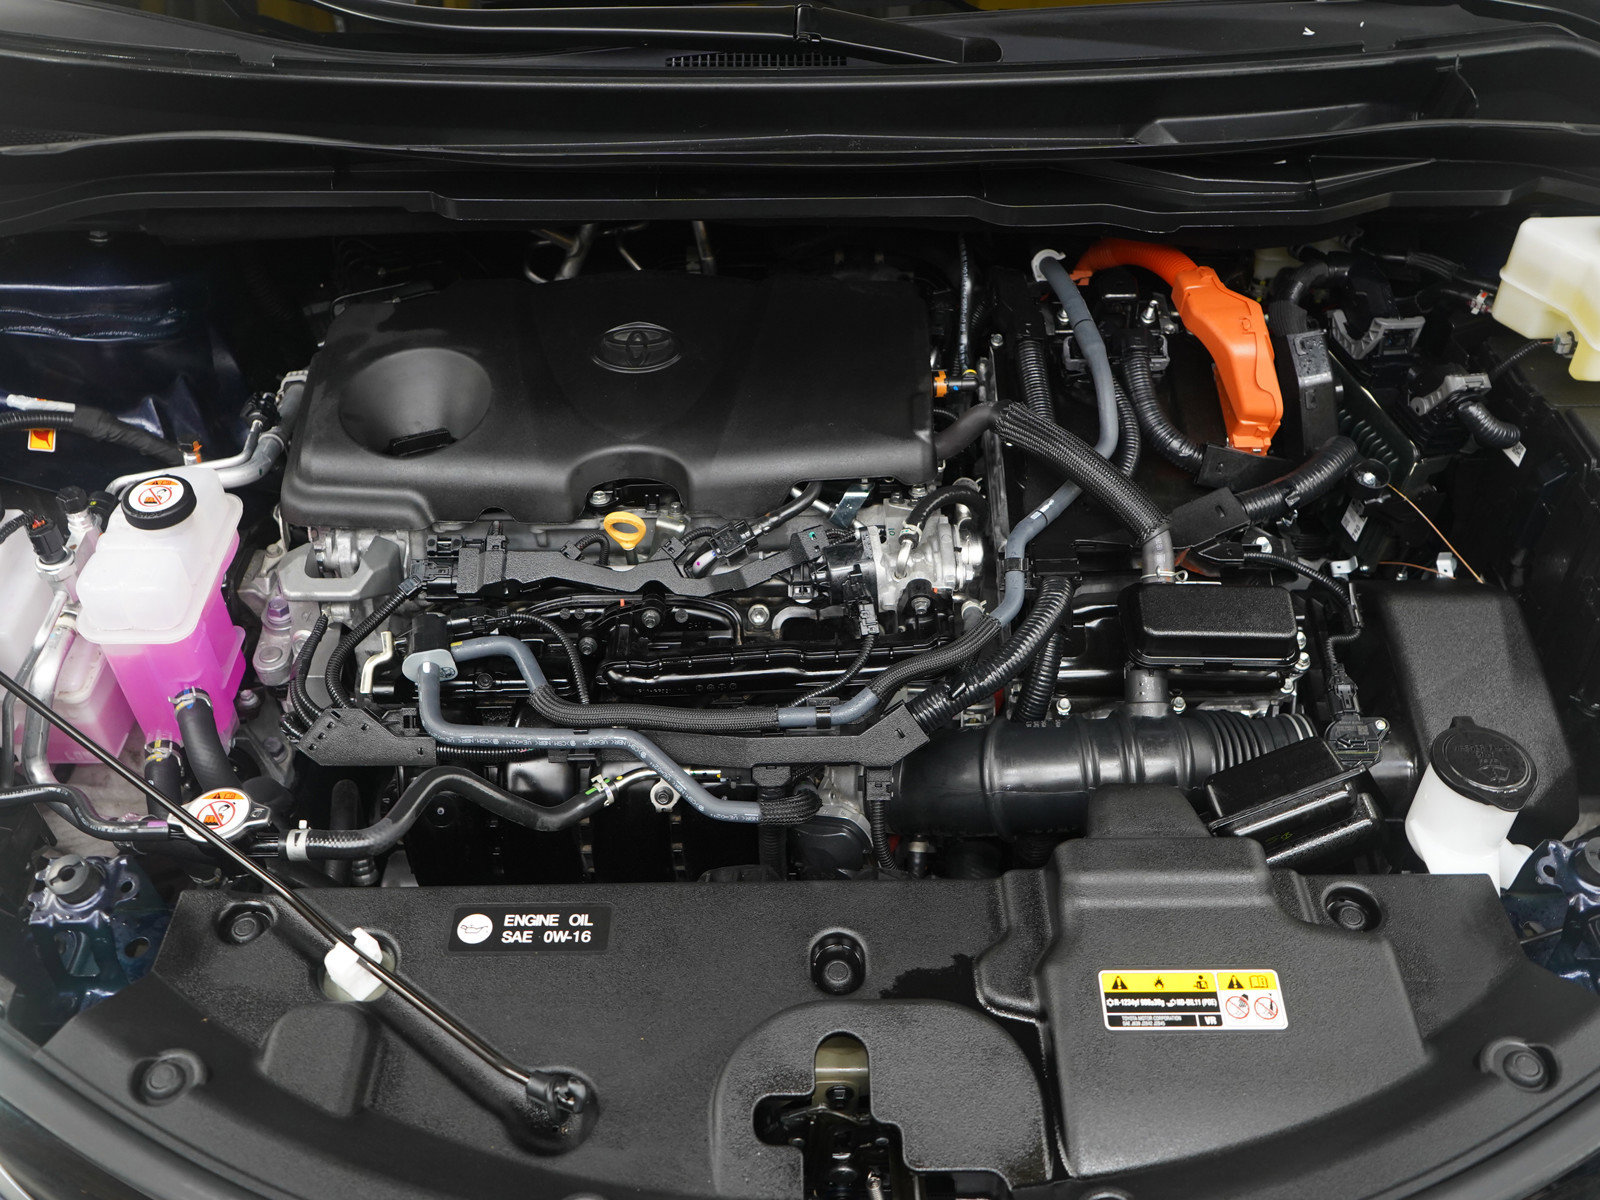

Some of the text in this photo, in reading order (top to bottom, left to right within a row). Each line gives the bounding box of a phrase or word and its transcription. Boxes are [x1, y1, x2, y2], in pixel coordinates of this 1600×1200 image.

[504, 914, 594, 927] ENGINE OIL
[501, 930, 592, 944] SAE 0W-16
